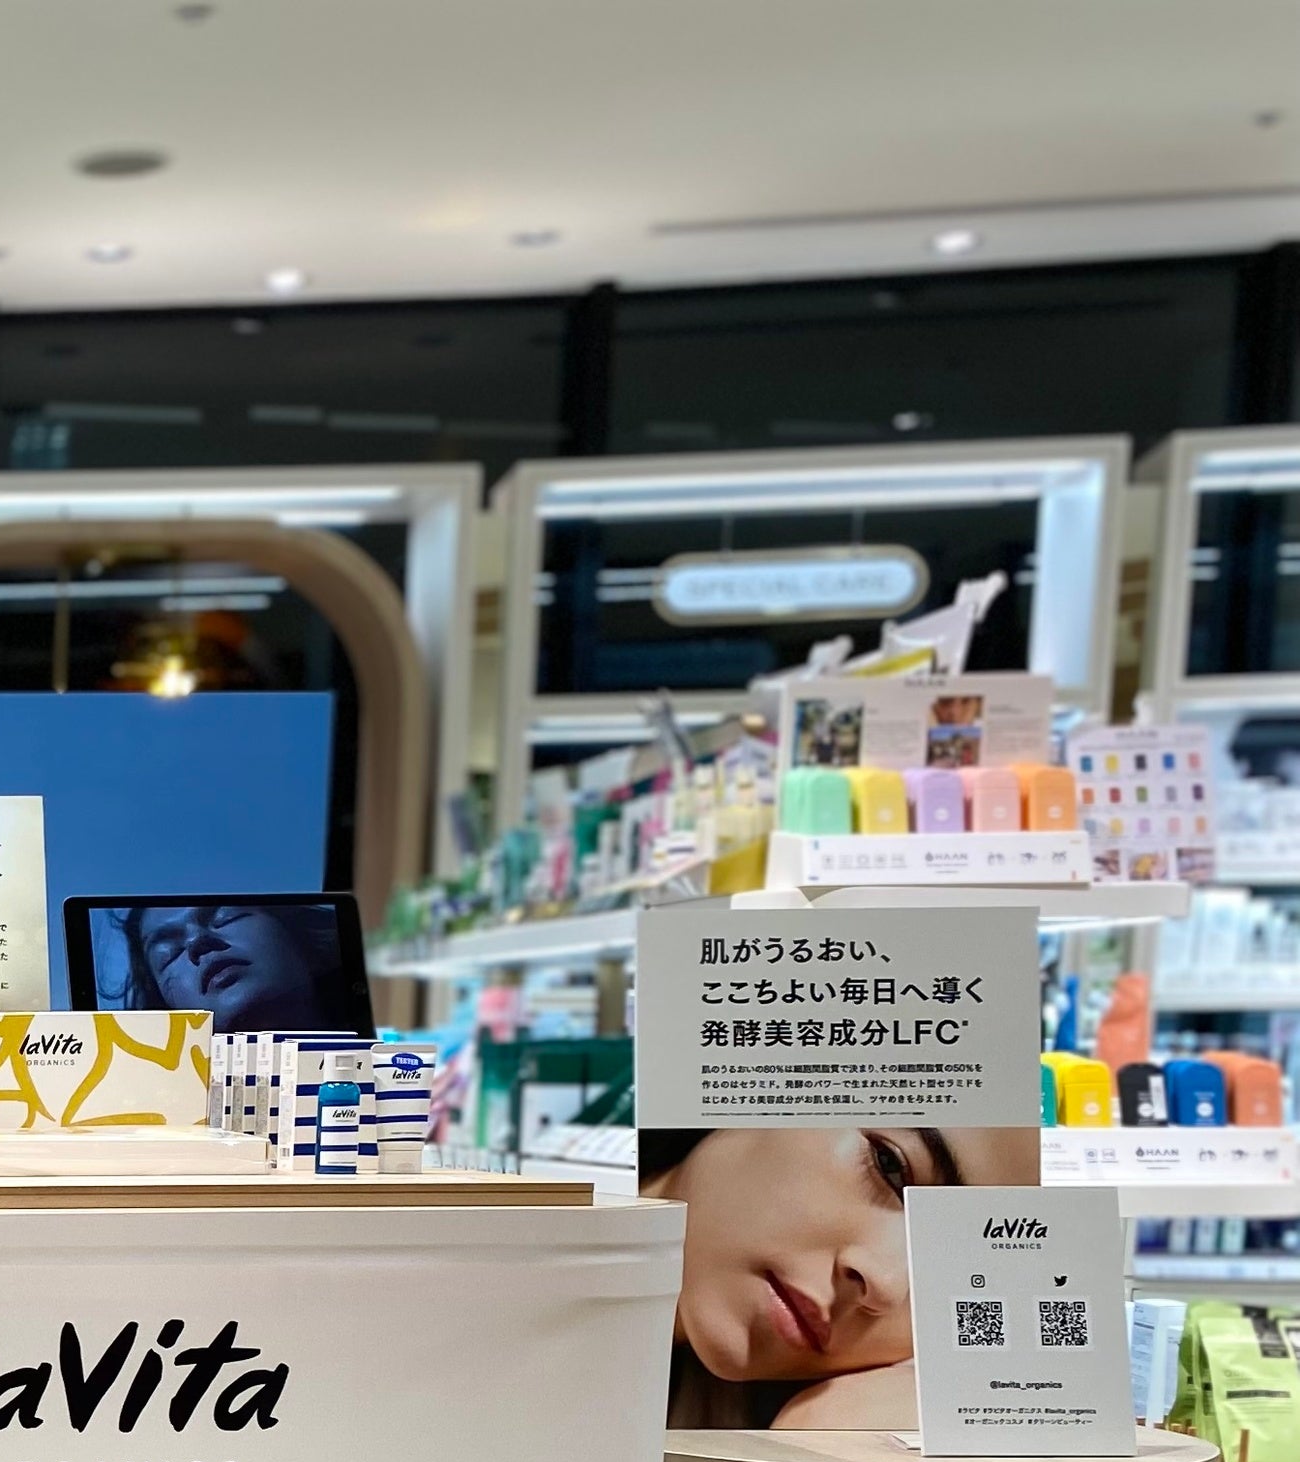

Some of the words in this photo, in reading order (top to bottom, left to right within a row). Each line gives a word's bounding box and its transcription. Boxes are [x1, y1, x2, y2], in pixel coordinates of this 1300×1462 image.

[700, 938, 890, 964] 肌がうるおい、
[702, 977, 983, 1005] ここちよい毎日へ導く
[18, 1031, 83, 1056] laVita
[983, 1218, 1047, 1238] laVita
[991, 1242, 1042, 1250] ORGANICS
